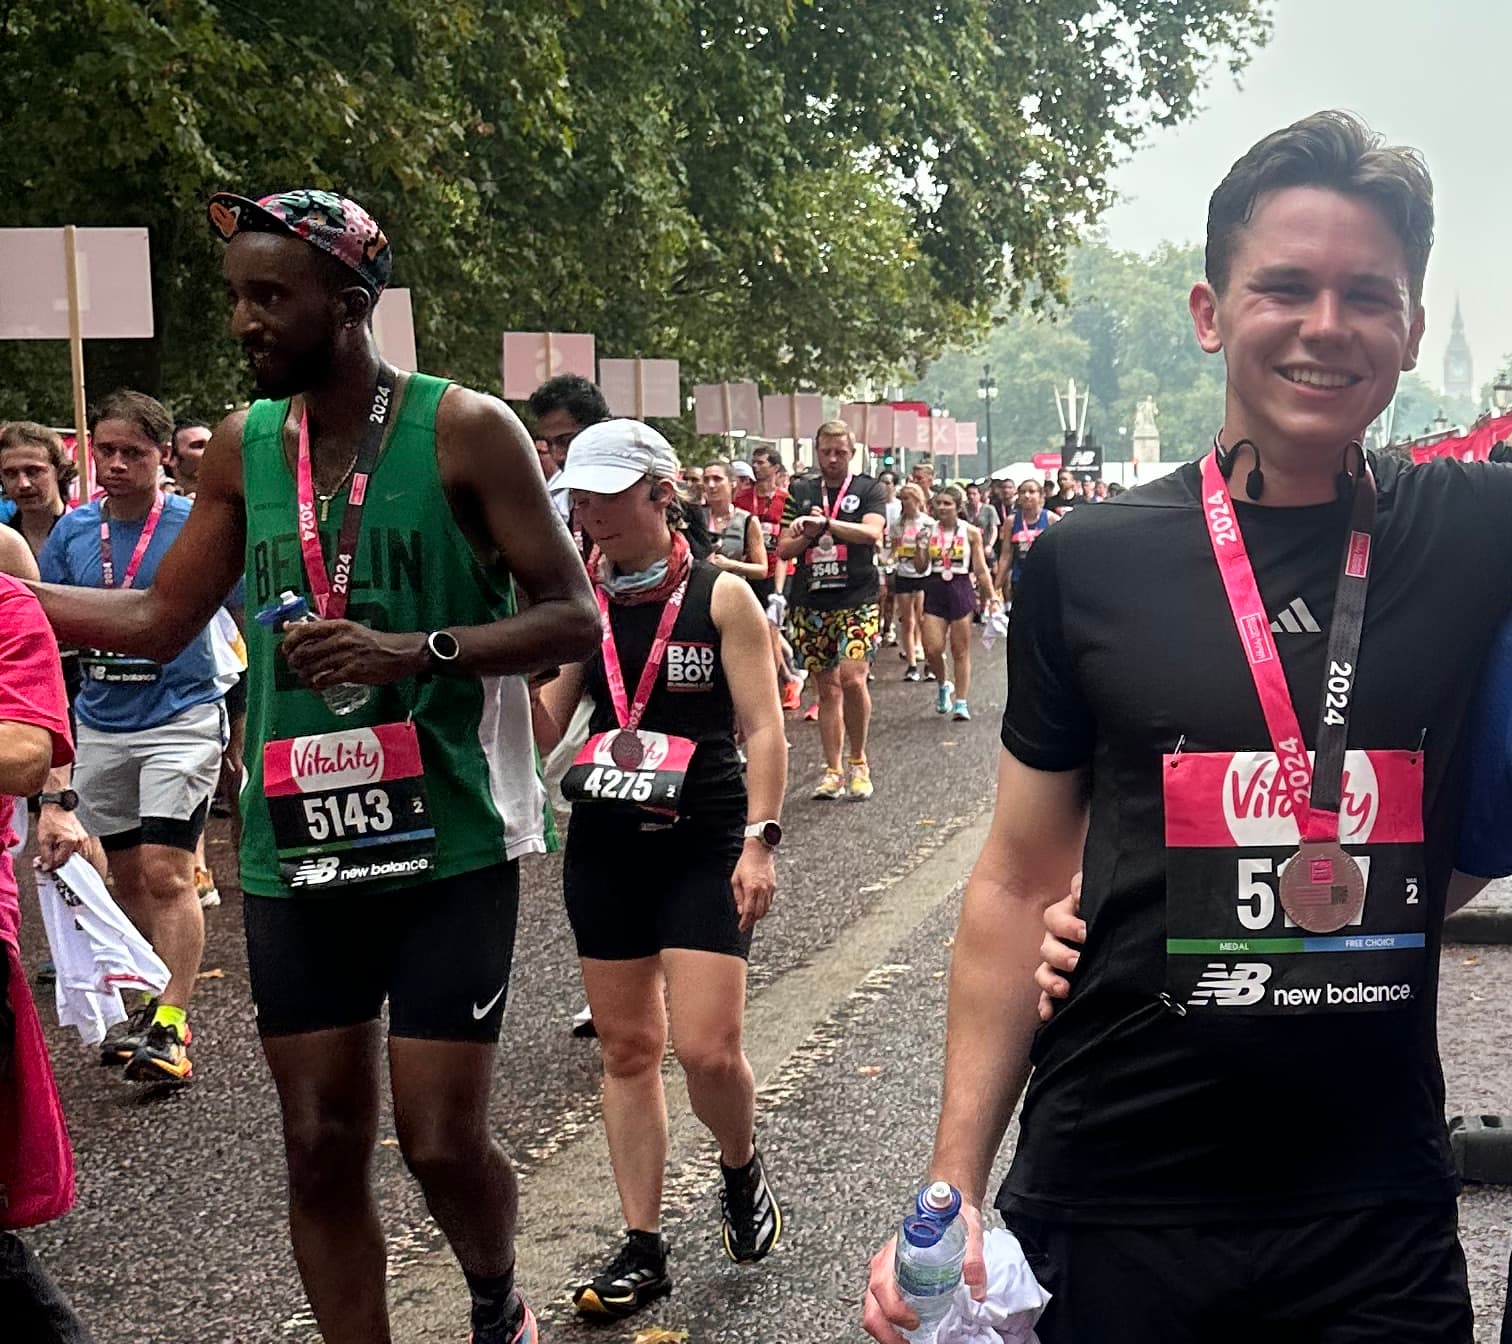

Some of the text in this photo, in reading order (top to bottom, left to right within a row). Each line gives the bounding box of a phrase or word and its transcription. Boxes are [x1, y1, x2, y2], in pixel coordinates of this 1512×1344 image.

[370, 386, 391, 423] 2024
[1207, 490, 1237, 545] 2024
[333, 554, 353, 594] 2024
[667, 645, 714, 664] BAD
[667, 665, 714, 682] BOY
[1322, 661, 1353, 726] 2024
[294, 739, 379, 779] Vitality
[1279, 736, 1311, 803] 2024
[584, 767, 656, 802] 4275
[303, 789, 393, 840] 5143
[413, 800, 424, 813] 2
[340, 866, 370, 880] new
[370, 858, 428, 875] balance
[1406, 884, 1419, 904] 2
[1219, 942, 1249, 951] MEDAL
[1345, 938, 1395, 948] FREE CHOICE
[1273, 987, 1321, 1005] new
[1327, 983, 1411, 1004] balance
